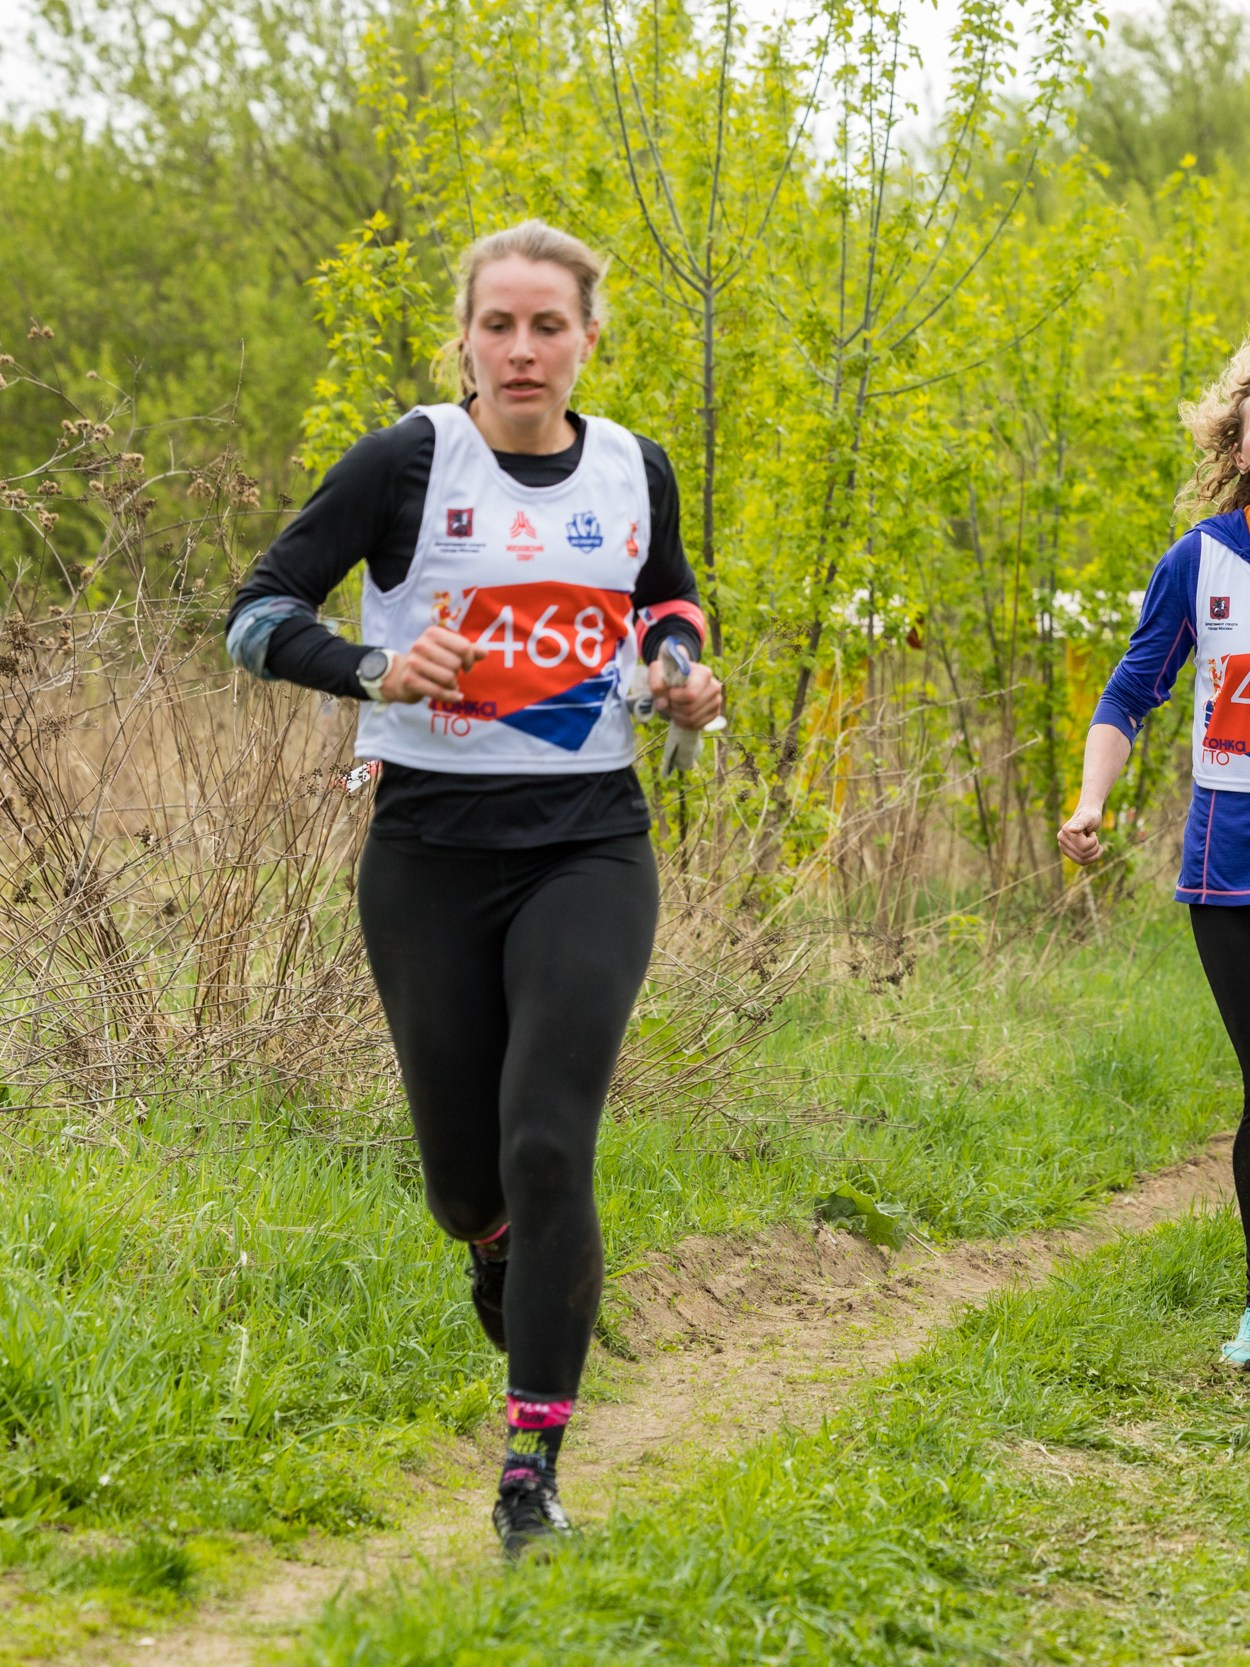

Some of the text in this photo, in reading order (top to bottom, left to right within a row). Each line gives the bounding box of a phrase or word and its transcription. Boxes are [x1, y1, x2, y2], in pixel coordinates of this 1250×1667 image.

[476, 605, 604, 668] 468
[430, 714, 471, 737] ГТО
[1202, 749, 1229, 766] ГТО
